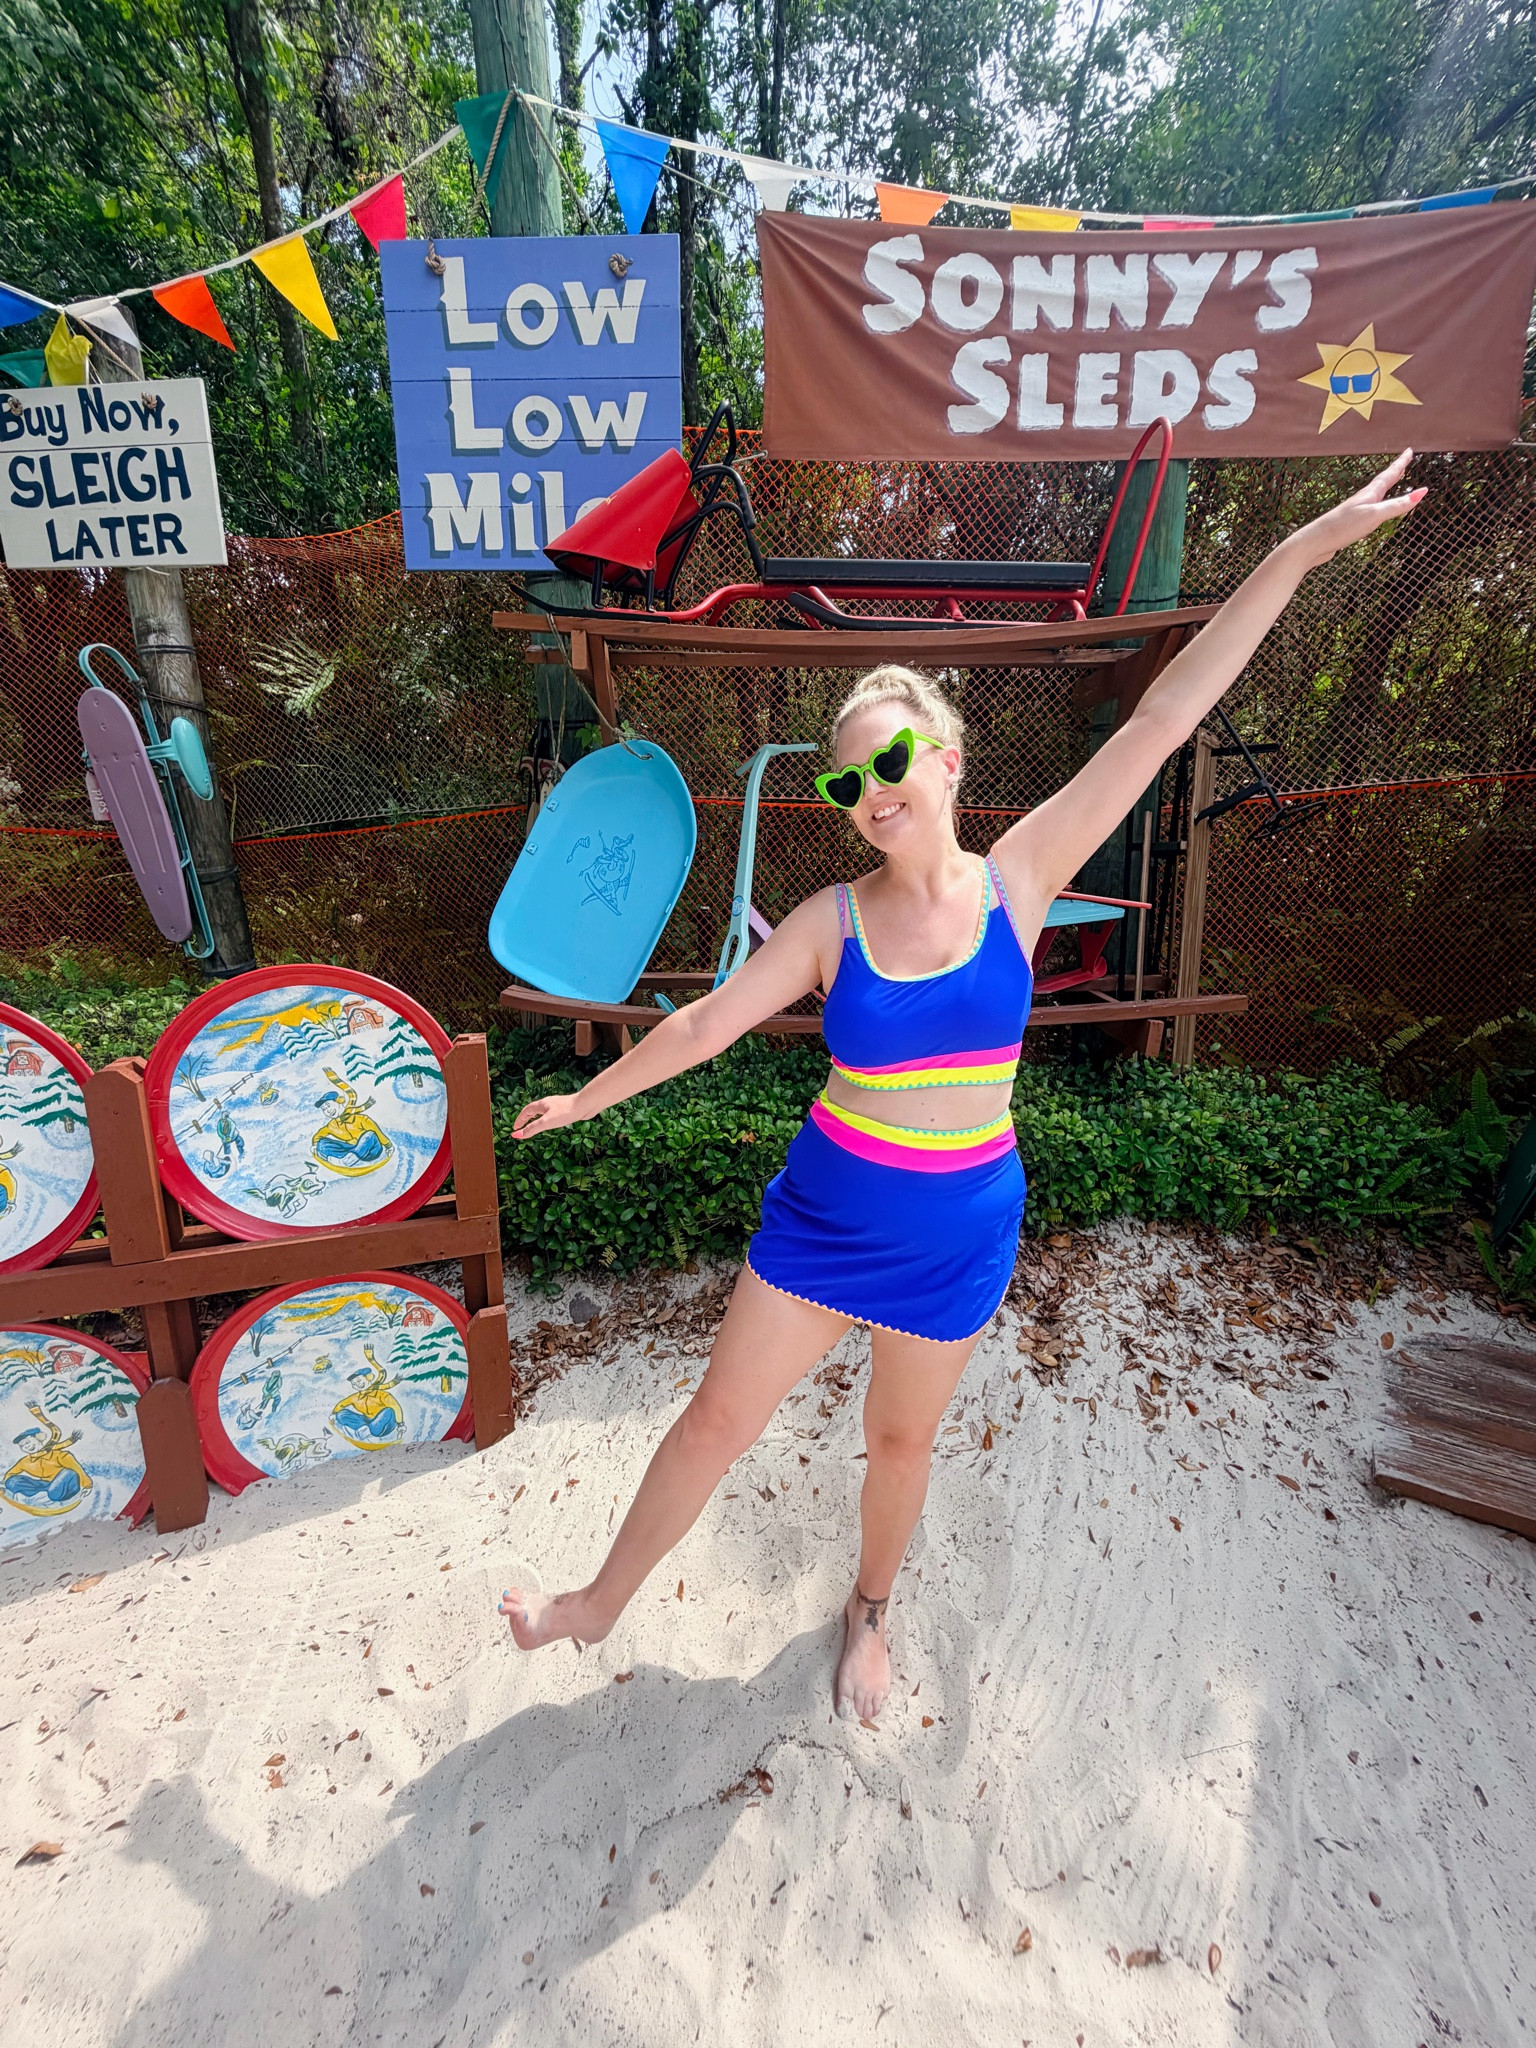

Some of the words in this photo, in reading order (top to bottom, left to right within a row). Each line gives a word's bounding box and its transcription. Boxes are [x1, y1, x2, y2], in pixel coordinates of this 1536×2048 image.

[862, 234, 1318, 334] SONNY'S
[0, 393, 69, 446] Buy
[77, 387, 180, 436] Now,
[947, 336, 1258, 434] SLEDS
[9, 446, 192, 509] SLEIGH
[424, 471, 613, 551] Mil
[46, 513, 188, 562] LATER
